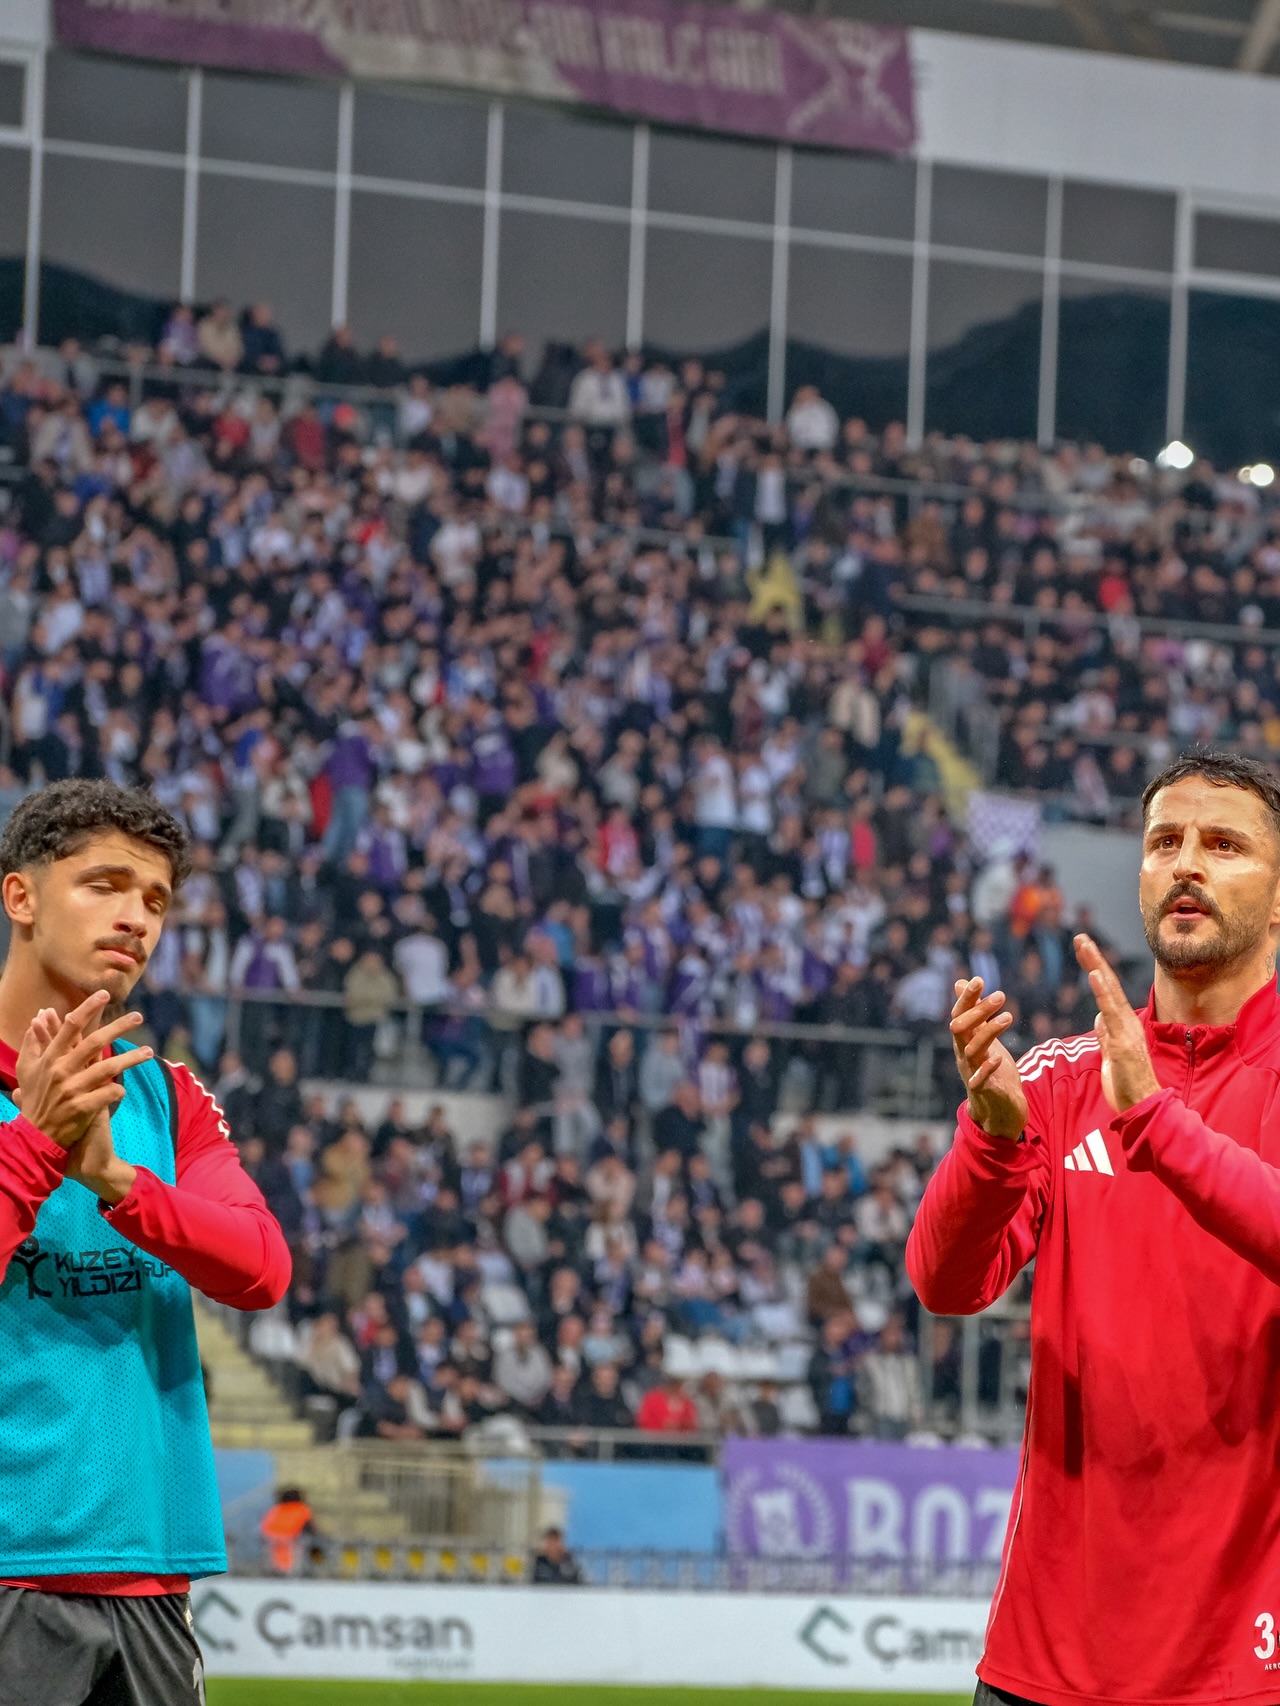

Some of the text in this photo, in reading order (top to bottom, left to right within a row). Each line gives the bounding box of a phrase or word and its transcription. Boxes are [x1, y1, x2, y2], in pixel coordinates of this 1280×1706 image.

[55, 1246, 138, 1273] KUZEY
[58, 1269, 142, 1298] YILDIZI
[255, 1599, 474, 1658] Çamsan
